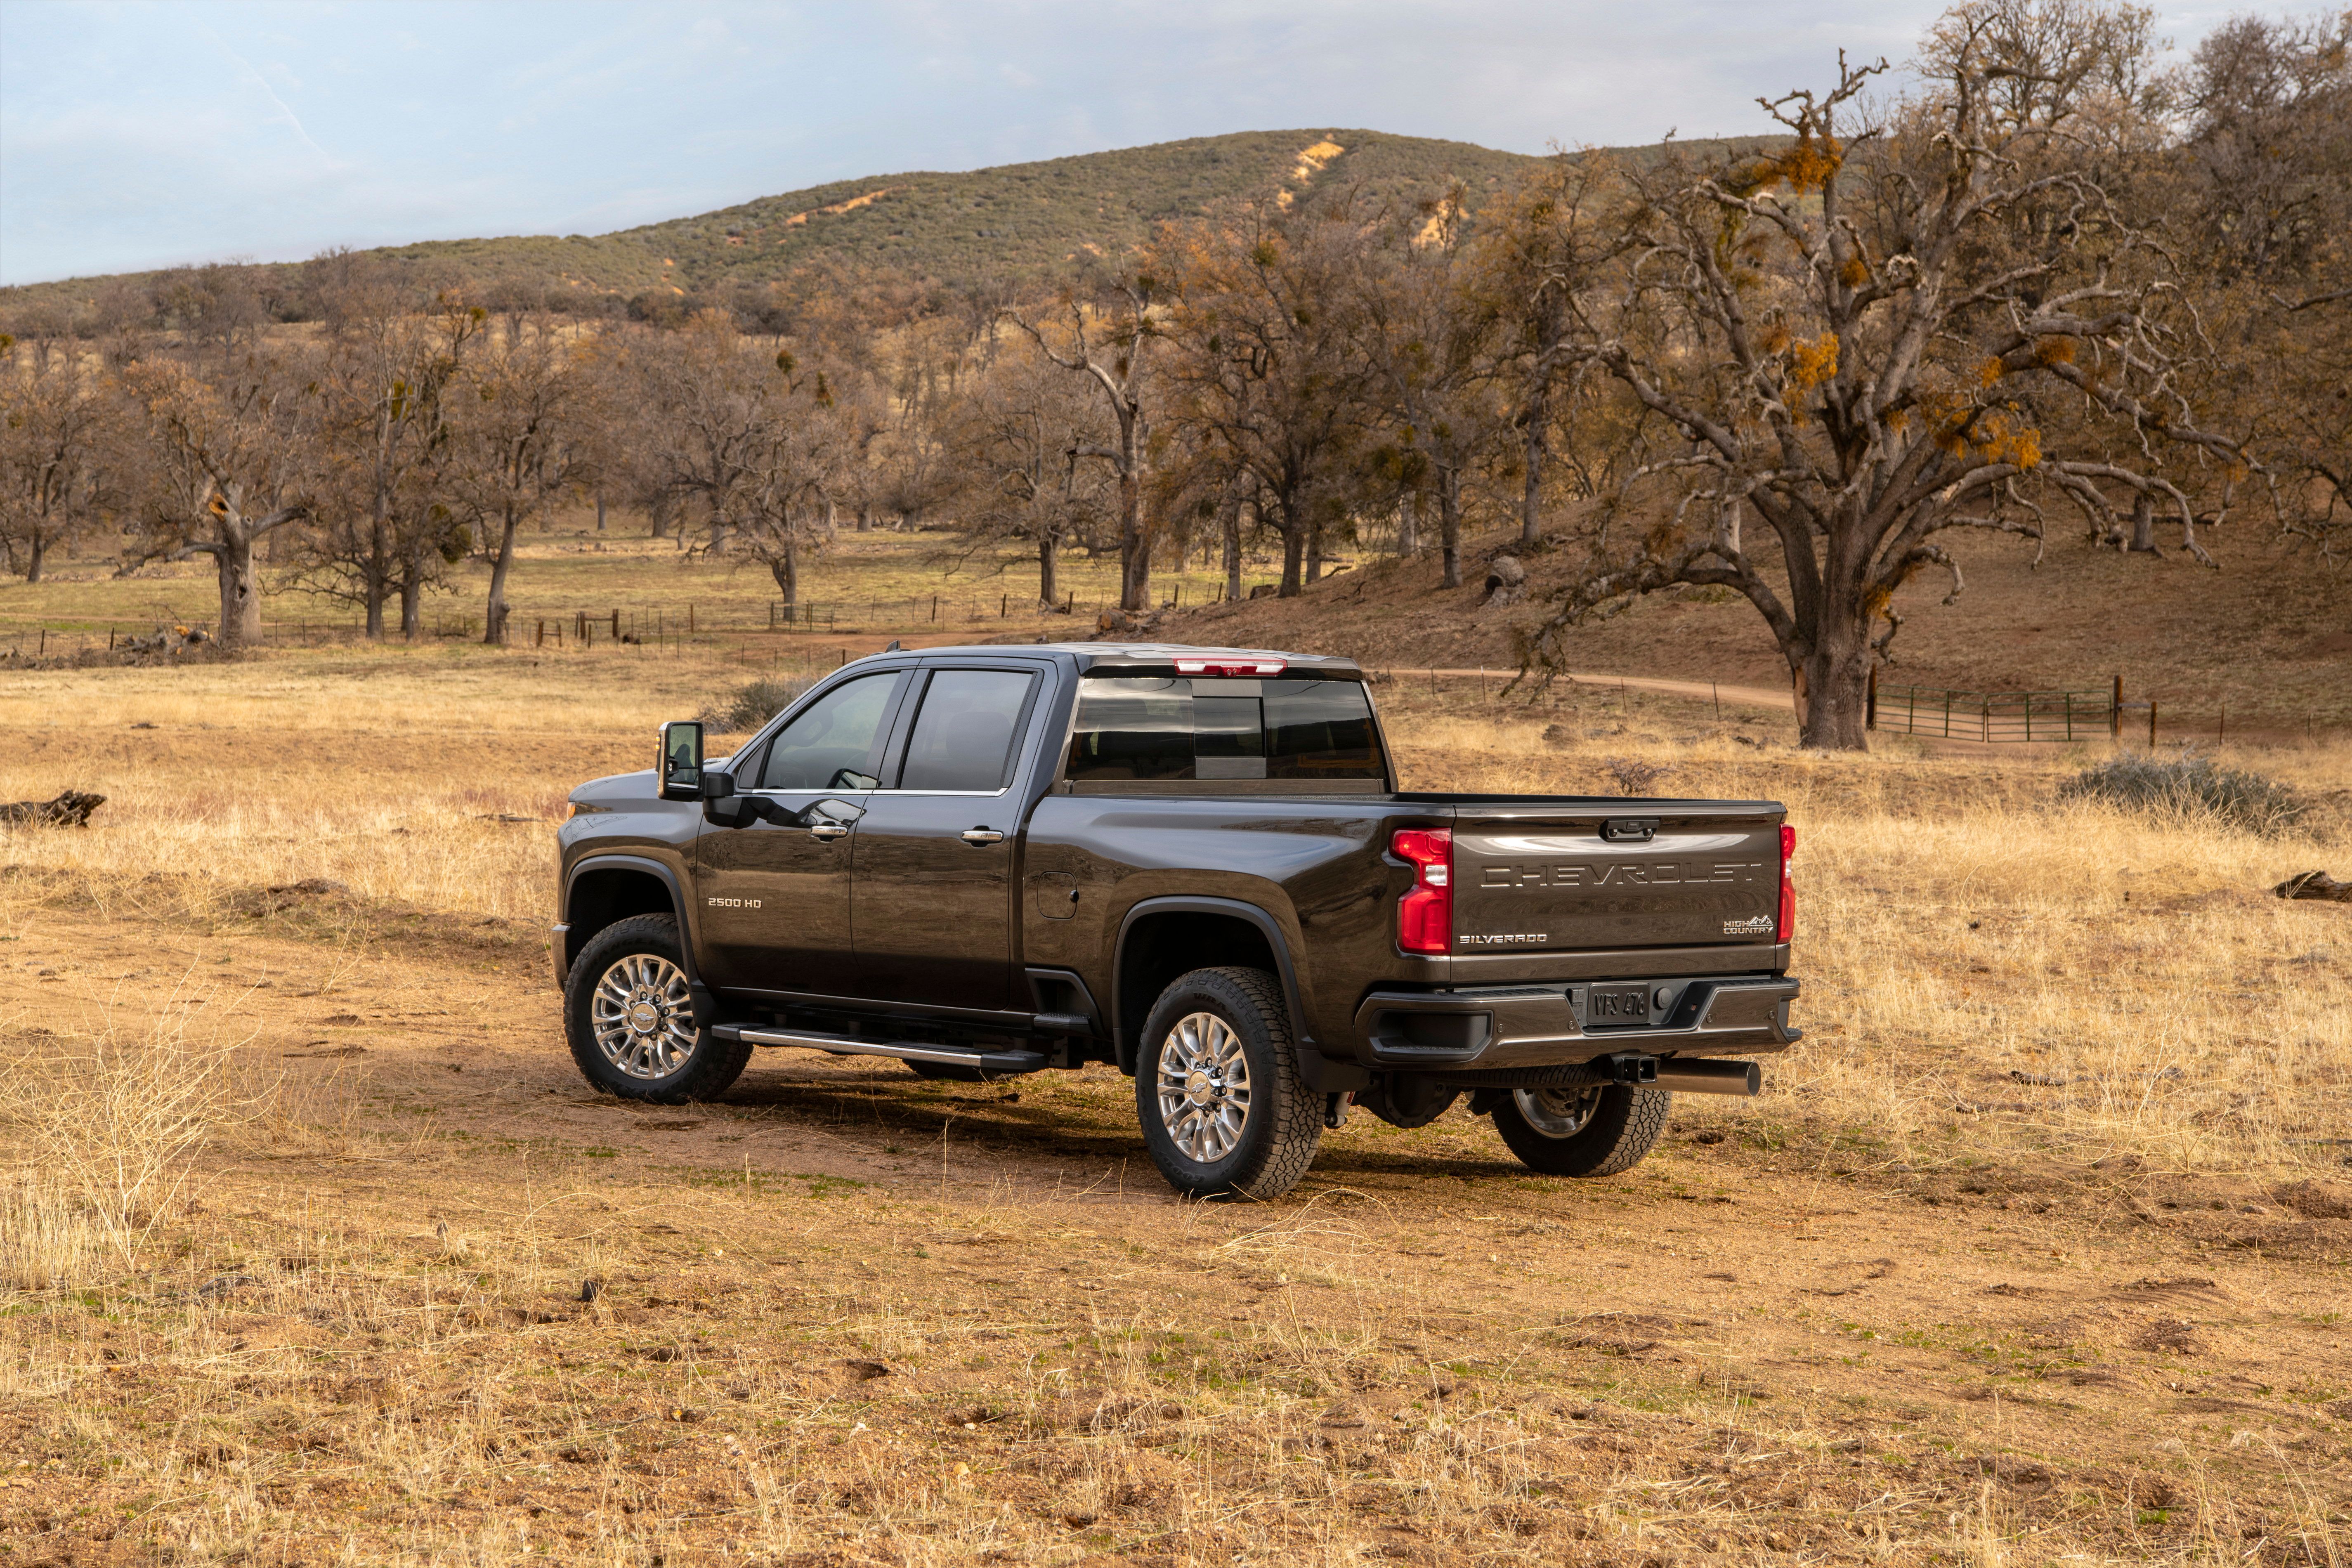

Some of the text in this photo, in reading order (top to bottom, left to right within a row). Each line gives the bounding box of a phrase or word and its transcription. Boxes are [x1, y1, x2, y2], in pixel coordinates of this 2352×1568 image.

[1481, 862, 1761, 887] CHEVROLET
[708, 897, 762, 908] 2500 HD
[1459, 934, 1547, 944] SILVERADO
[1594, 992, 1645, 1015] VFS 476
